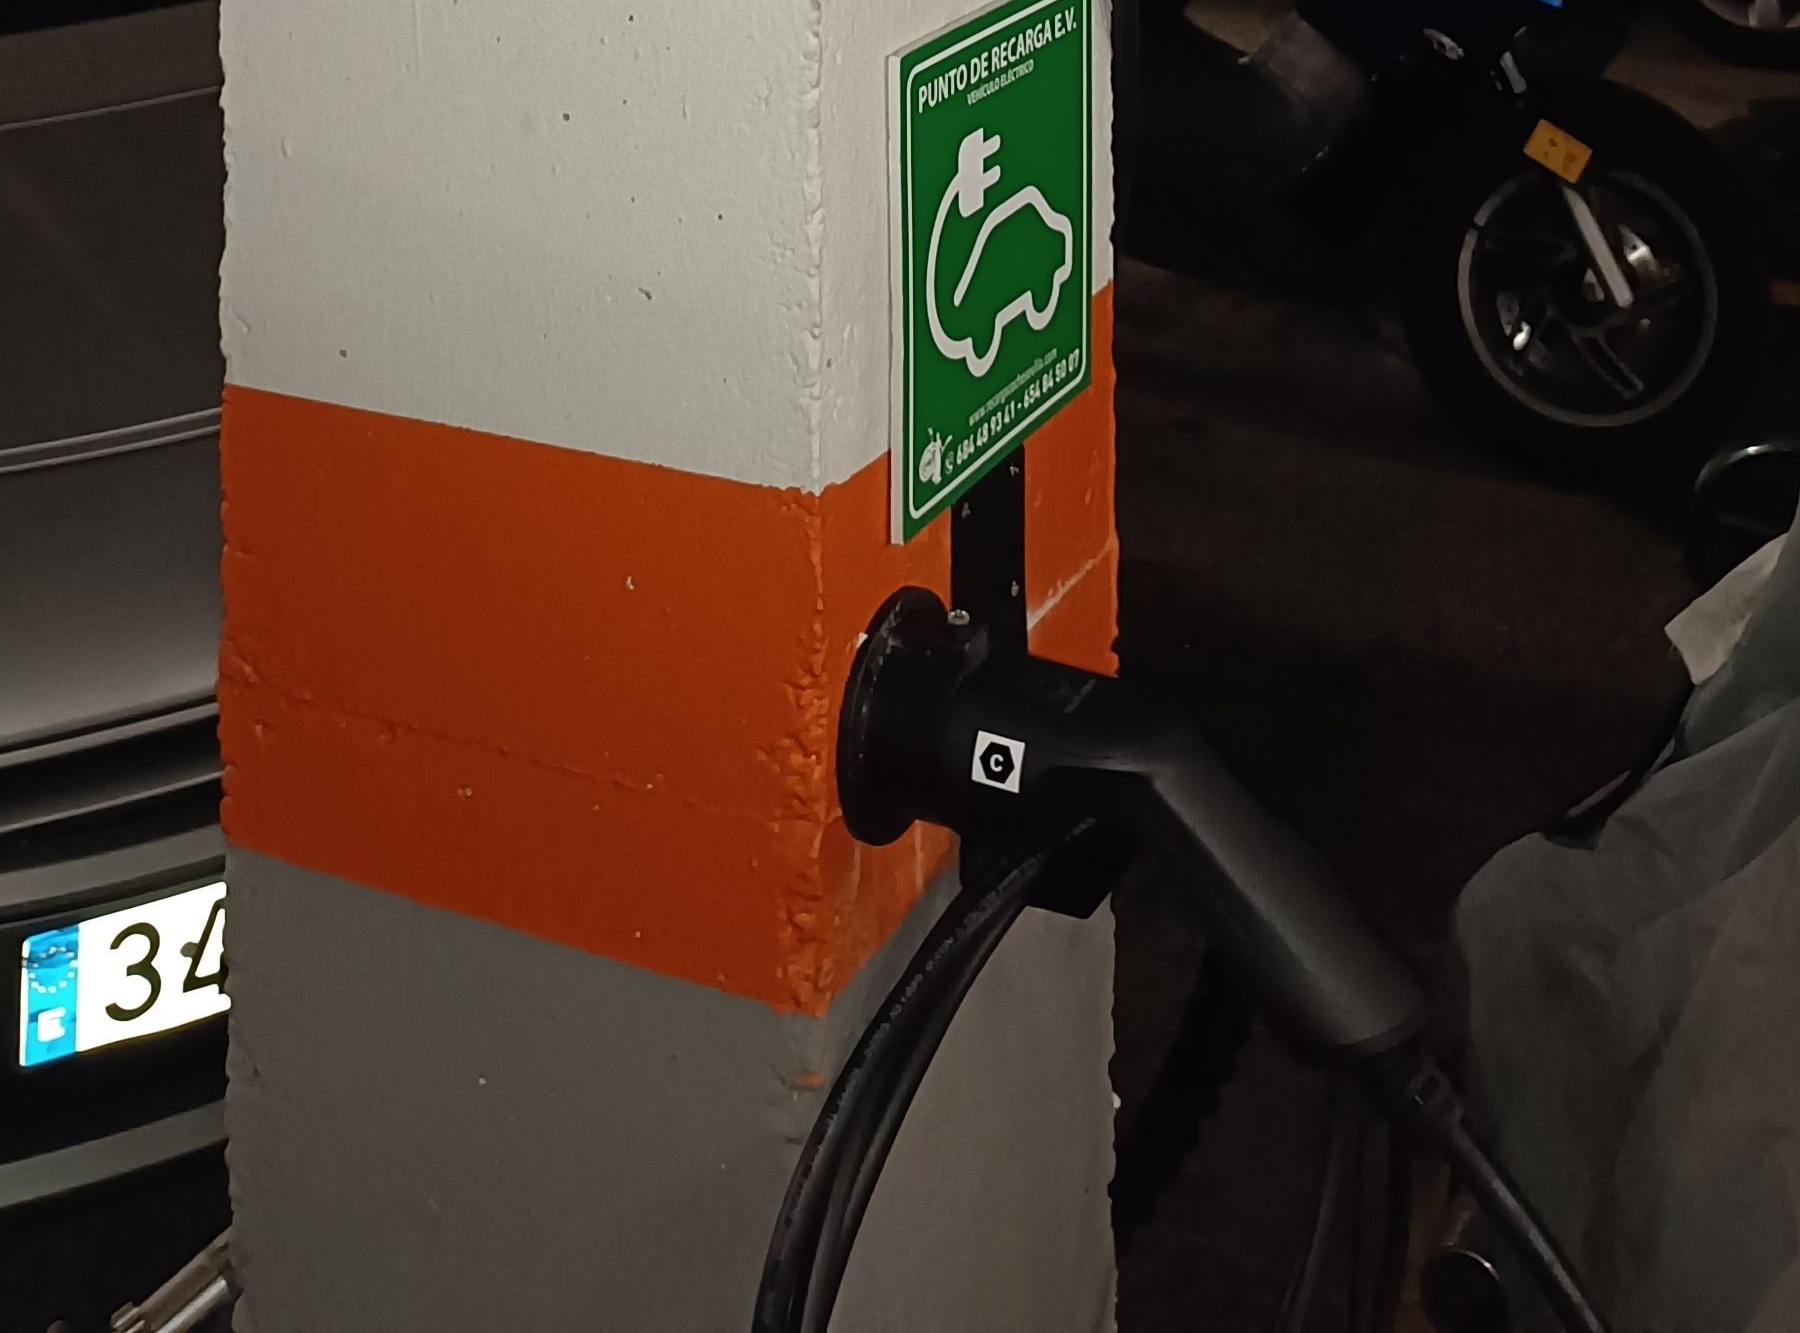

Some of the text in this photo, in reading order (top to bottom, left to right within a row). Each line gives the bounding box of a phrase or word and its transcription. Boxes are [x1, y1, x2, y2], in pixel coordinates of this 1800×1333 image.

[918, 6, 1077, 114] PUNTO DE RECARGA E.V.
[956, 434, 975, 465] 684
[976, 422, 989, 447] 48
[990, 411, 1003, 436] 93
[1003, 399, 1015, 424] 41
[1023, 379, 1041, 409] 654
[1055, 358, 1067, 383] 50
[1068, 348, 1080, 373] 07
[989, 753, 1005, 773] C
